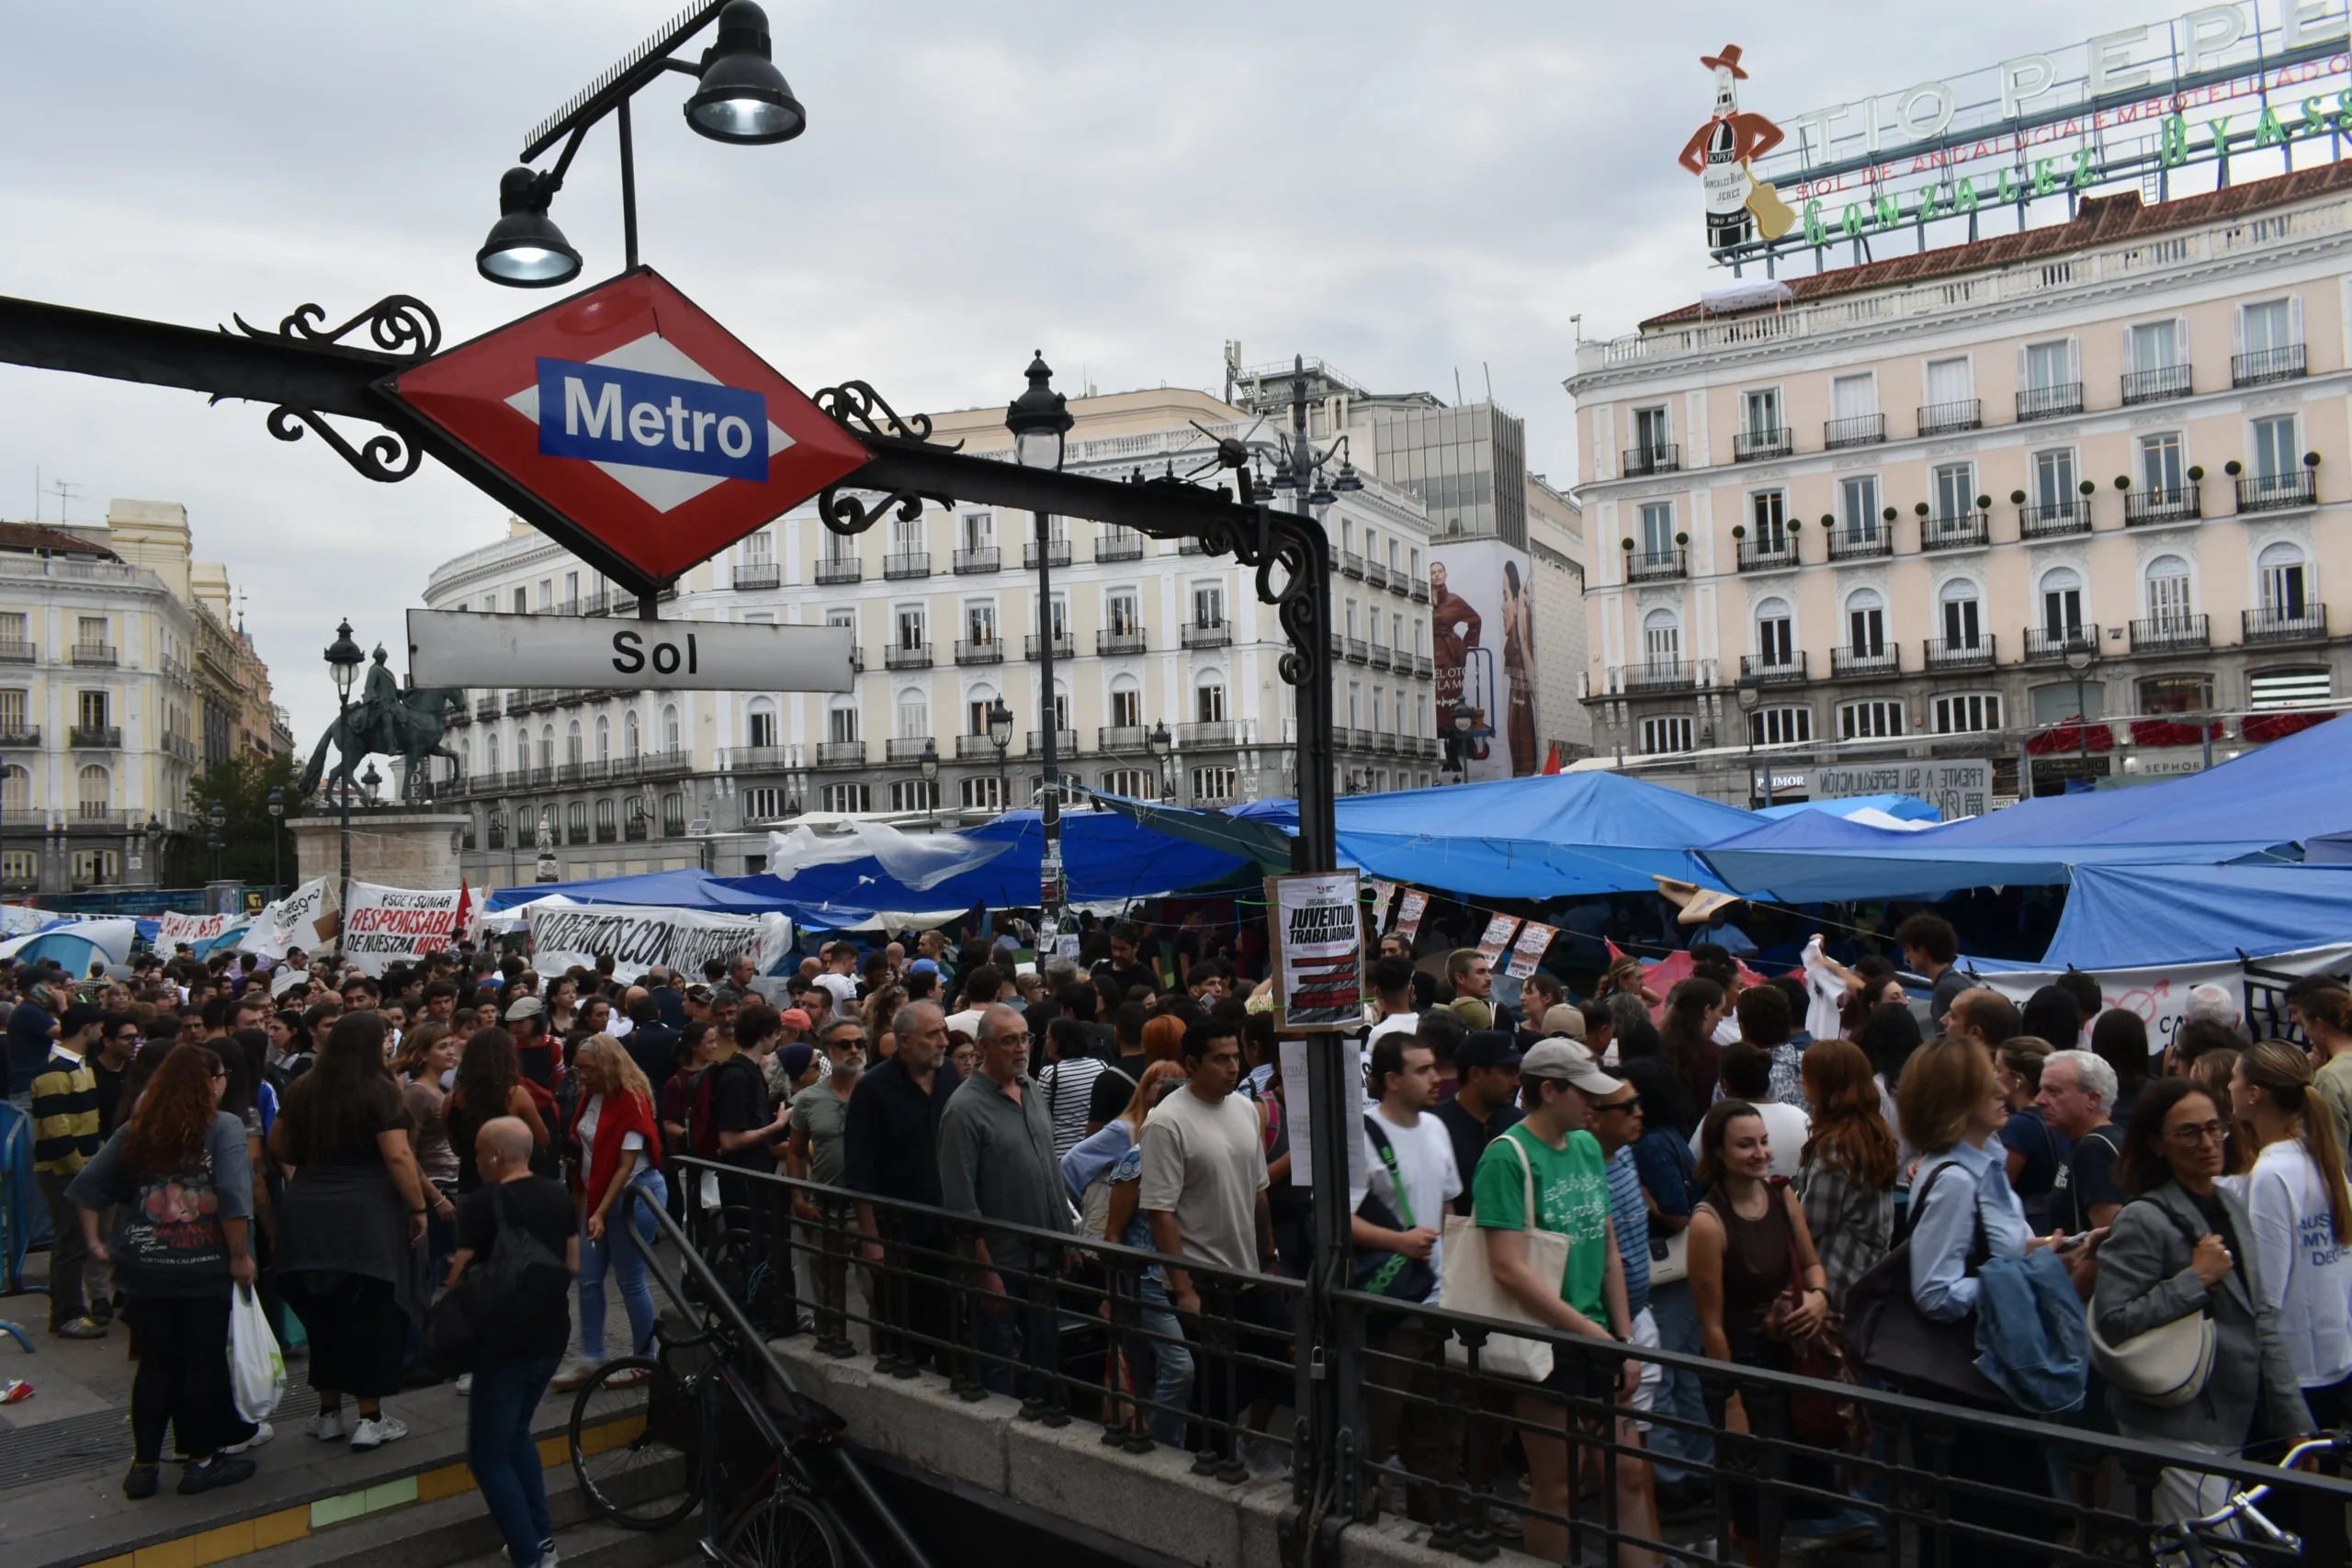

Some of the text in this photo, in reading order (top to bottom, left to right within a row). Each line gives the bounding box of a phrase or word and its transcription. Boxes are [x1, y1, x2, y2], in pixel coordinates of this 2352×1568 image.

[1797, 0, 2349, 164] TIO PEPE
[1796, 54, 2349, 200] SOL DE ANDALUCIA EMBOTELLADO
[1716, 188, 1741, 201] JEREZ
[1804, 145, 2095, 245] GONZALEZ
[563, 377, 752, 458] Metro
[612, 630, 698, 674] Sol
[1437, 680, 1451, 690] LA
[2145, 761, 2203, 773] SEPHOR
[1757, 775, 1805, 787] PIMOR
[381, 894, 408, 908] PSOE
[414, 895, 453, 908] SUMAR
[1288, 905, 1353, 930] JUVENTUD
[347, 934, 366, 952] DE
[361, 934, 415, 954] NUESTRA
[618, 919, 675, 965] CON
[1289, 925, 1355, 945] TRABAJADORA
[140, 1254, 220, 1265] NORTHERN CALIFORNIA
